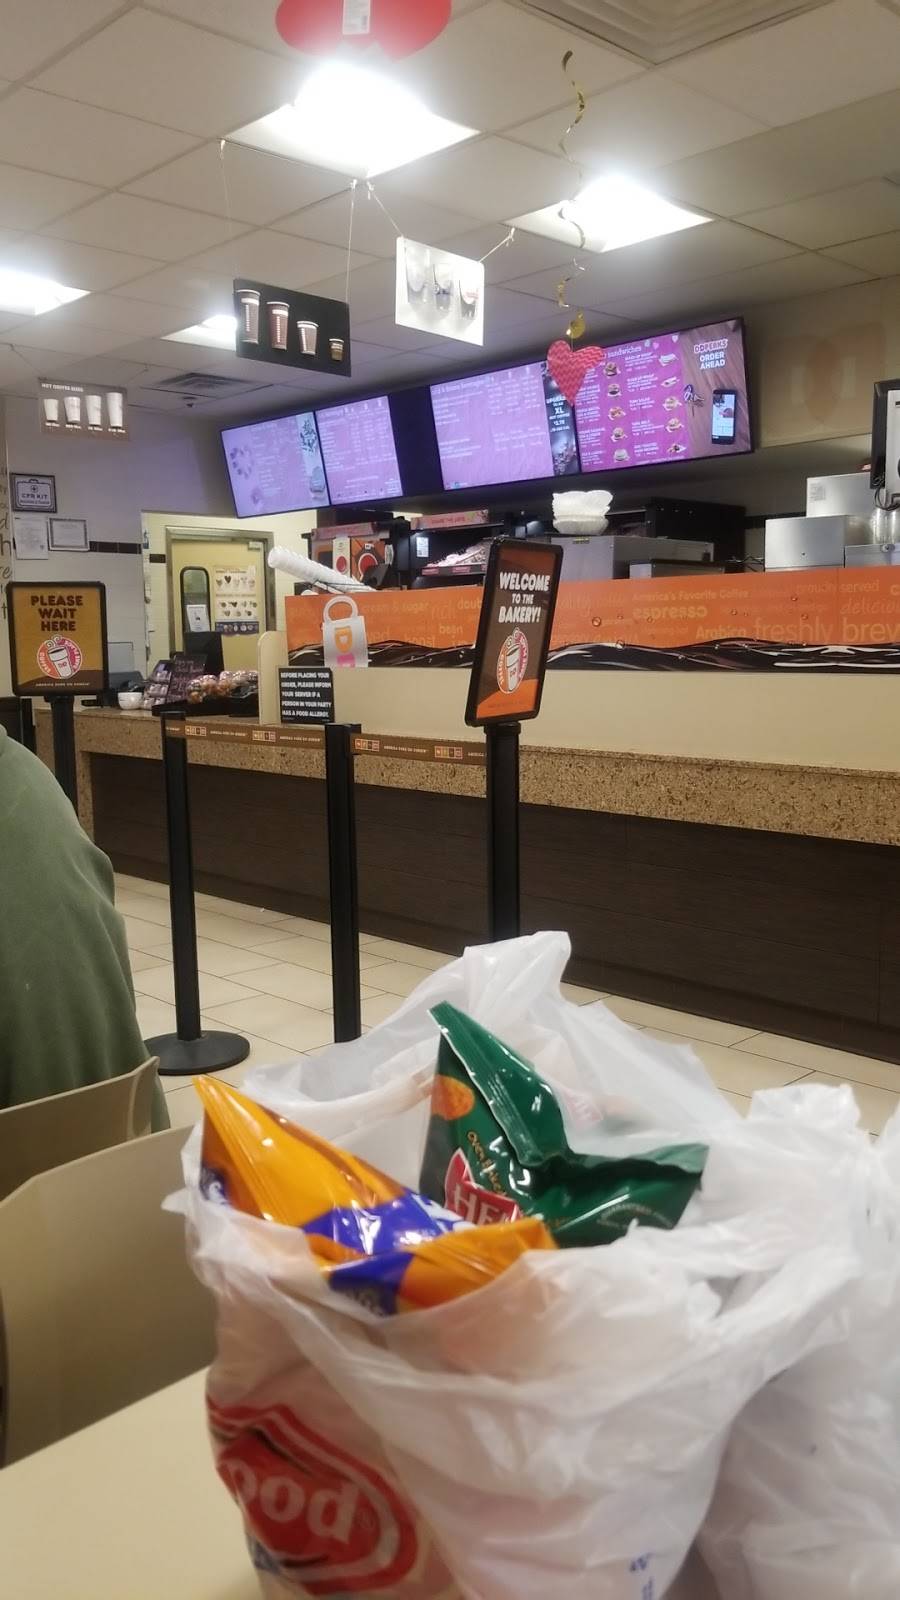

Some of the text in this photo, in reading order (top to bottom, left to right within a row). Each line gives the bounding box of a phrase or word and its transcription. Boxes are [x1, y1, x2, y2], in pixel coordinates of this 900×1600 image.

[700, 351, 724, 361] ORDER
[700, 360, 725, 370] AHEAD
[499, 571, 551, 591] WELCOME
[511, 593, 534, 605] TO THE
[678, 589, 717, 600] Favorite
[30, 595, 83, 606] PLEASE
[38, 608, 77, 619] WAIT
[498, 606, 541, 623] BAKERY!
[635, 606, 708, 621] espresso
[40, 620, 76, 631] HERE
[753, 616, 833, 644] freshly
